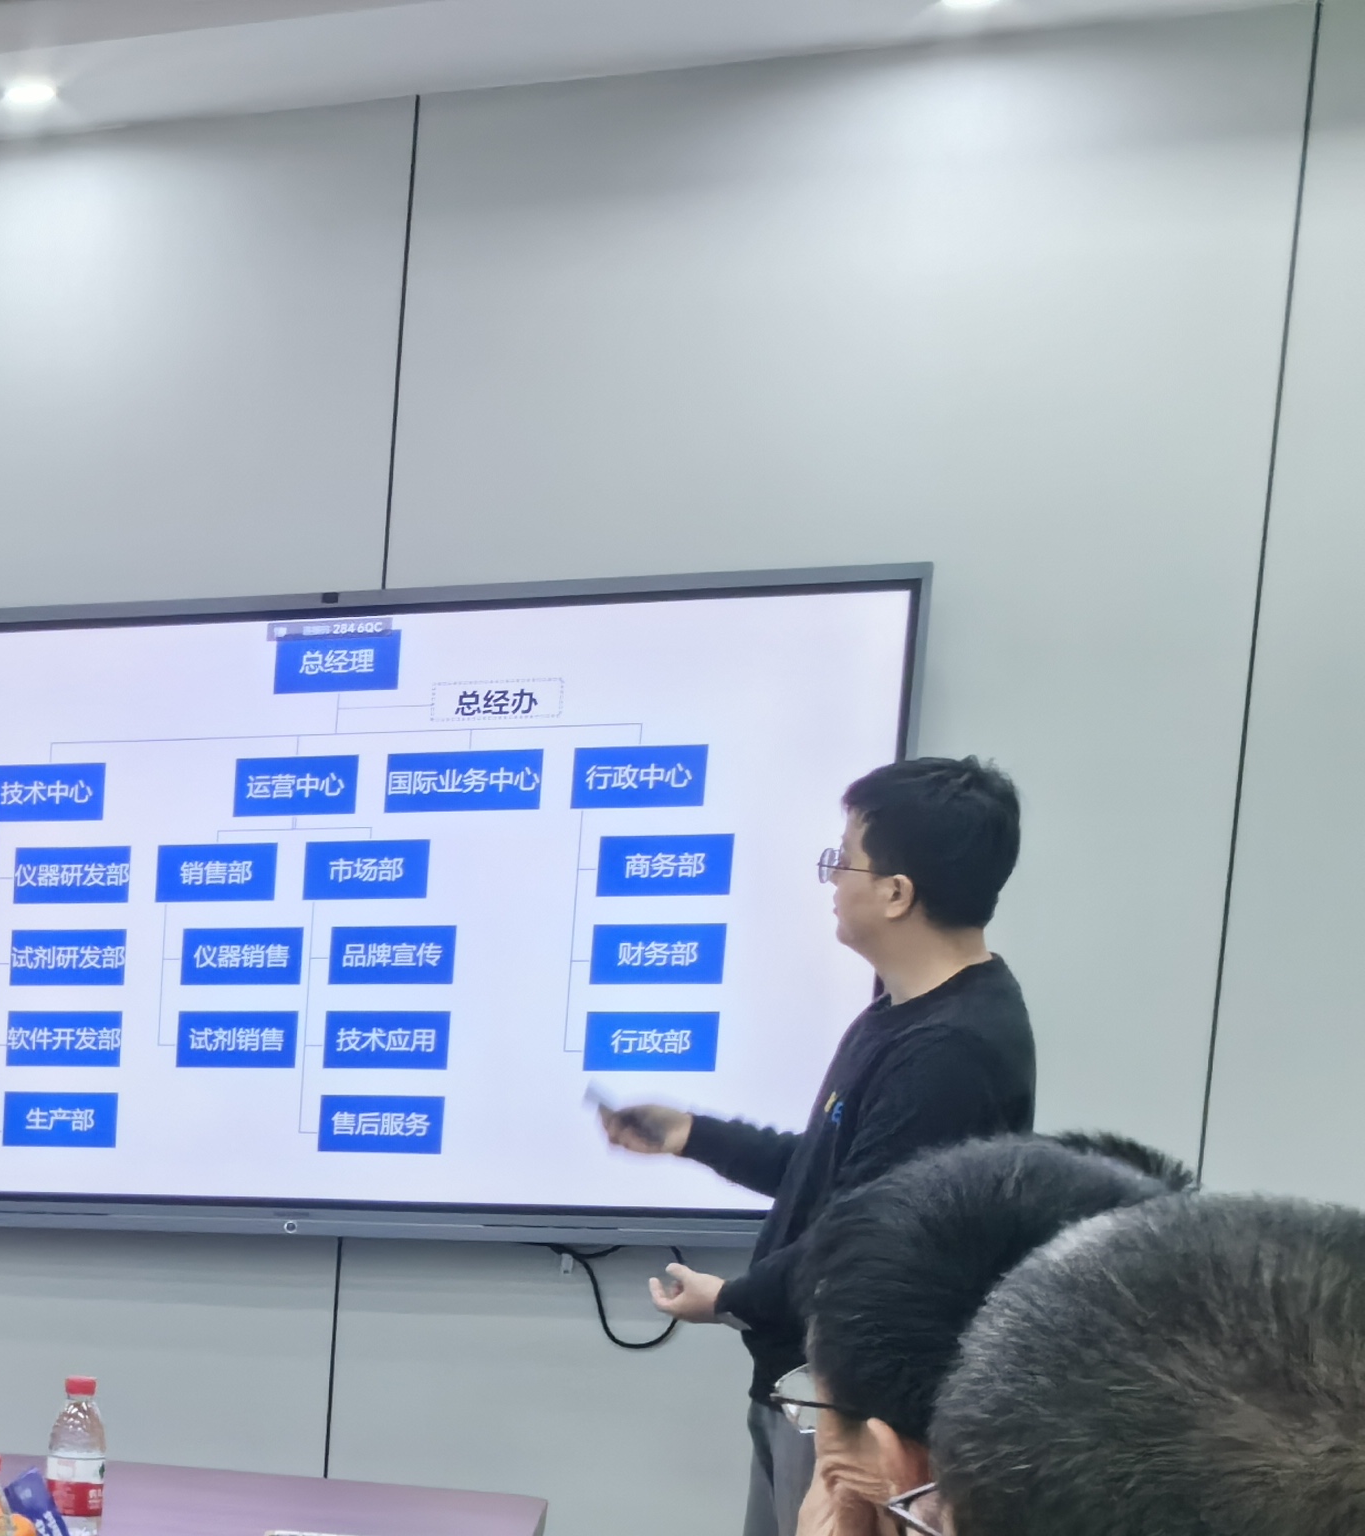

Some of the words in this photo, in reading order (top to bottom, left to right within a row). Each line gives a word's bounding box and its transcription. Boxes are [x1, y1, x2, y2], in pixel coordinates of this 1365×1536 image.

[299, 648, 375, 675] 总经理
[454, 688, 538, 716] 总经办
[245, 772, 345, 799] 运营中心
[387, 766, 540, 795] 国际业务中心
[585, 762, 692, 791] 行政中心
[0, 780, 93, 806] 技术中心
[14, 862, 130, 886] 仪器研发部
[180, 860, 253, 885] 销售部
[329, 858, 404, 882] 市场部
[625, 853, 705, 879] 商务部
[11, 945, 125, 969] 试剂研发部
[193, 944, 290, 969] 仪器销售
[342, 943, 442, 968] 品牌宣传
[617, 941, 698, 967] 财务部
[7, 1027, 121, 1051] 软件开发部
[188, 1028, 284, 1052] 试剂销售
[335, 1028, 436, 1053] 技术应用
[610, 1029, 692, 1055] 行政部
[25, 1108, 95, 1131] 生产部
[331, 1112, 431, 1136] 售后服务
